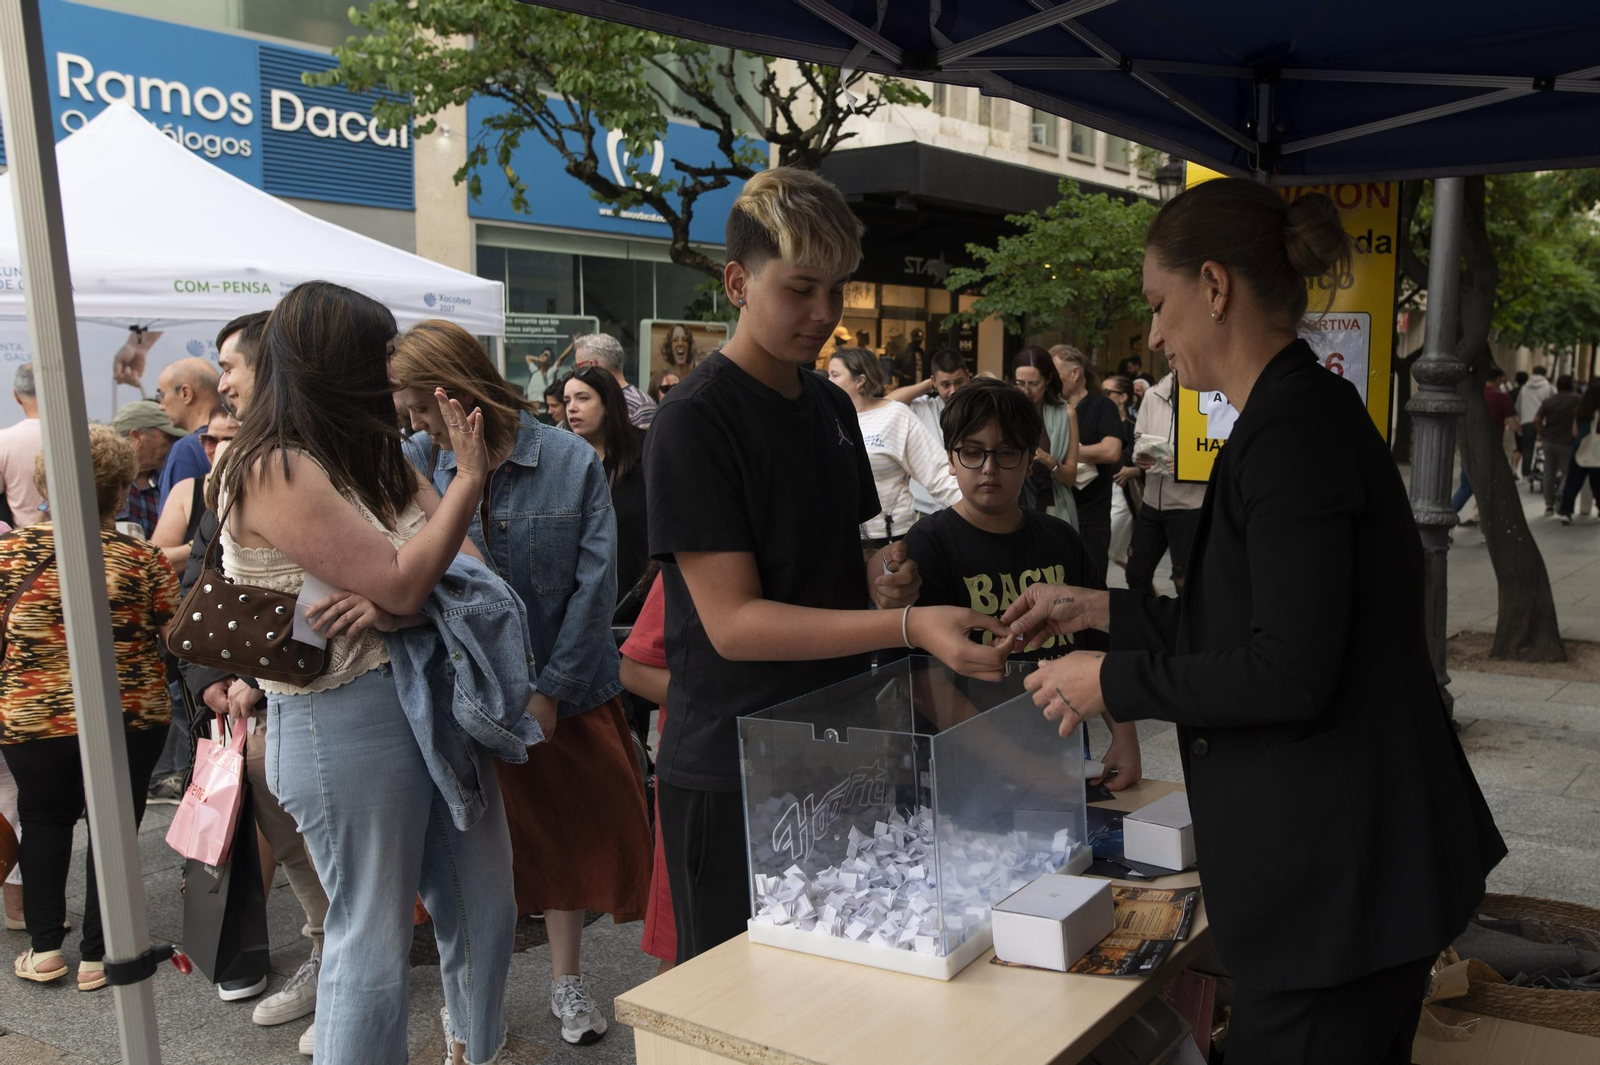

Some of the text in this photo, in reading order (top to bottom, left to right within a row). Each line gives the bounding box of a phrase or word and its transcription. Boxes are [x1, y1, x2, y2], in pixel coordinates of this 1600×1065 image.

[57, 52, 253, 125] Ramos
[1354, 229, 1392, 254] da
[1196, 437, 1228, 452] HA
